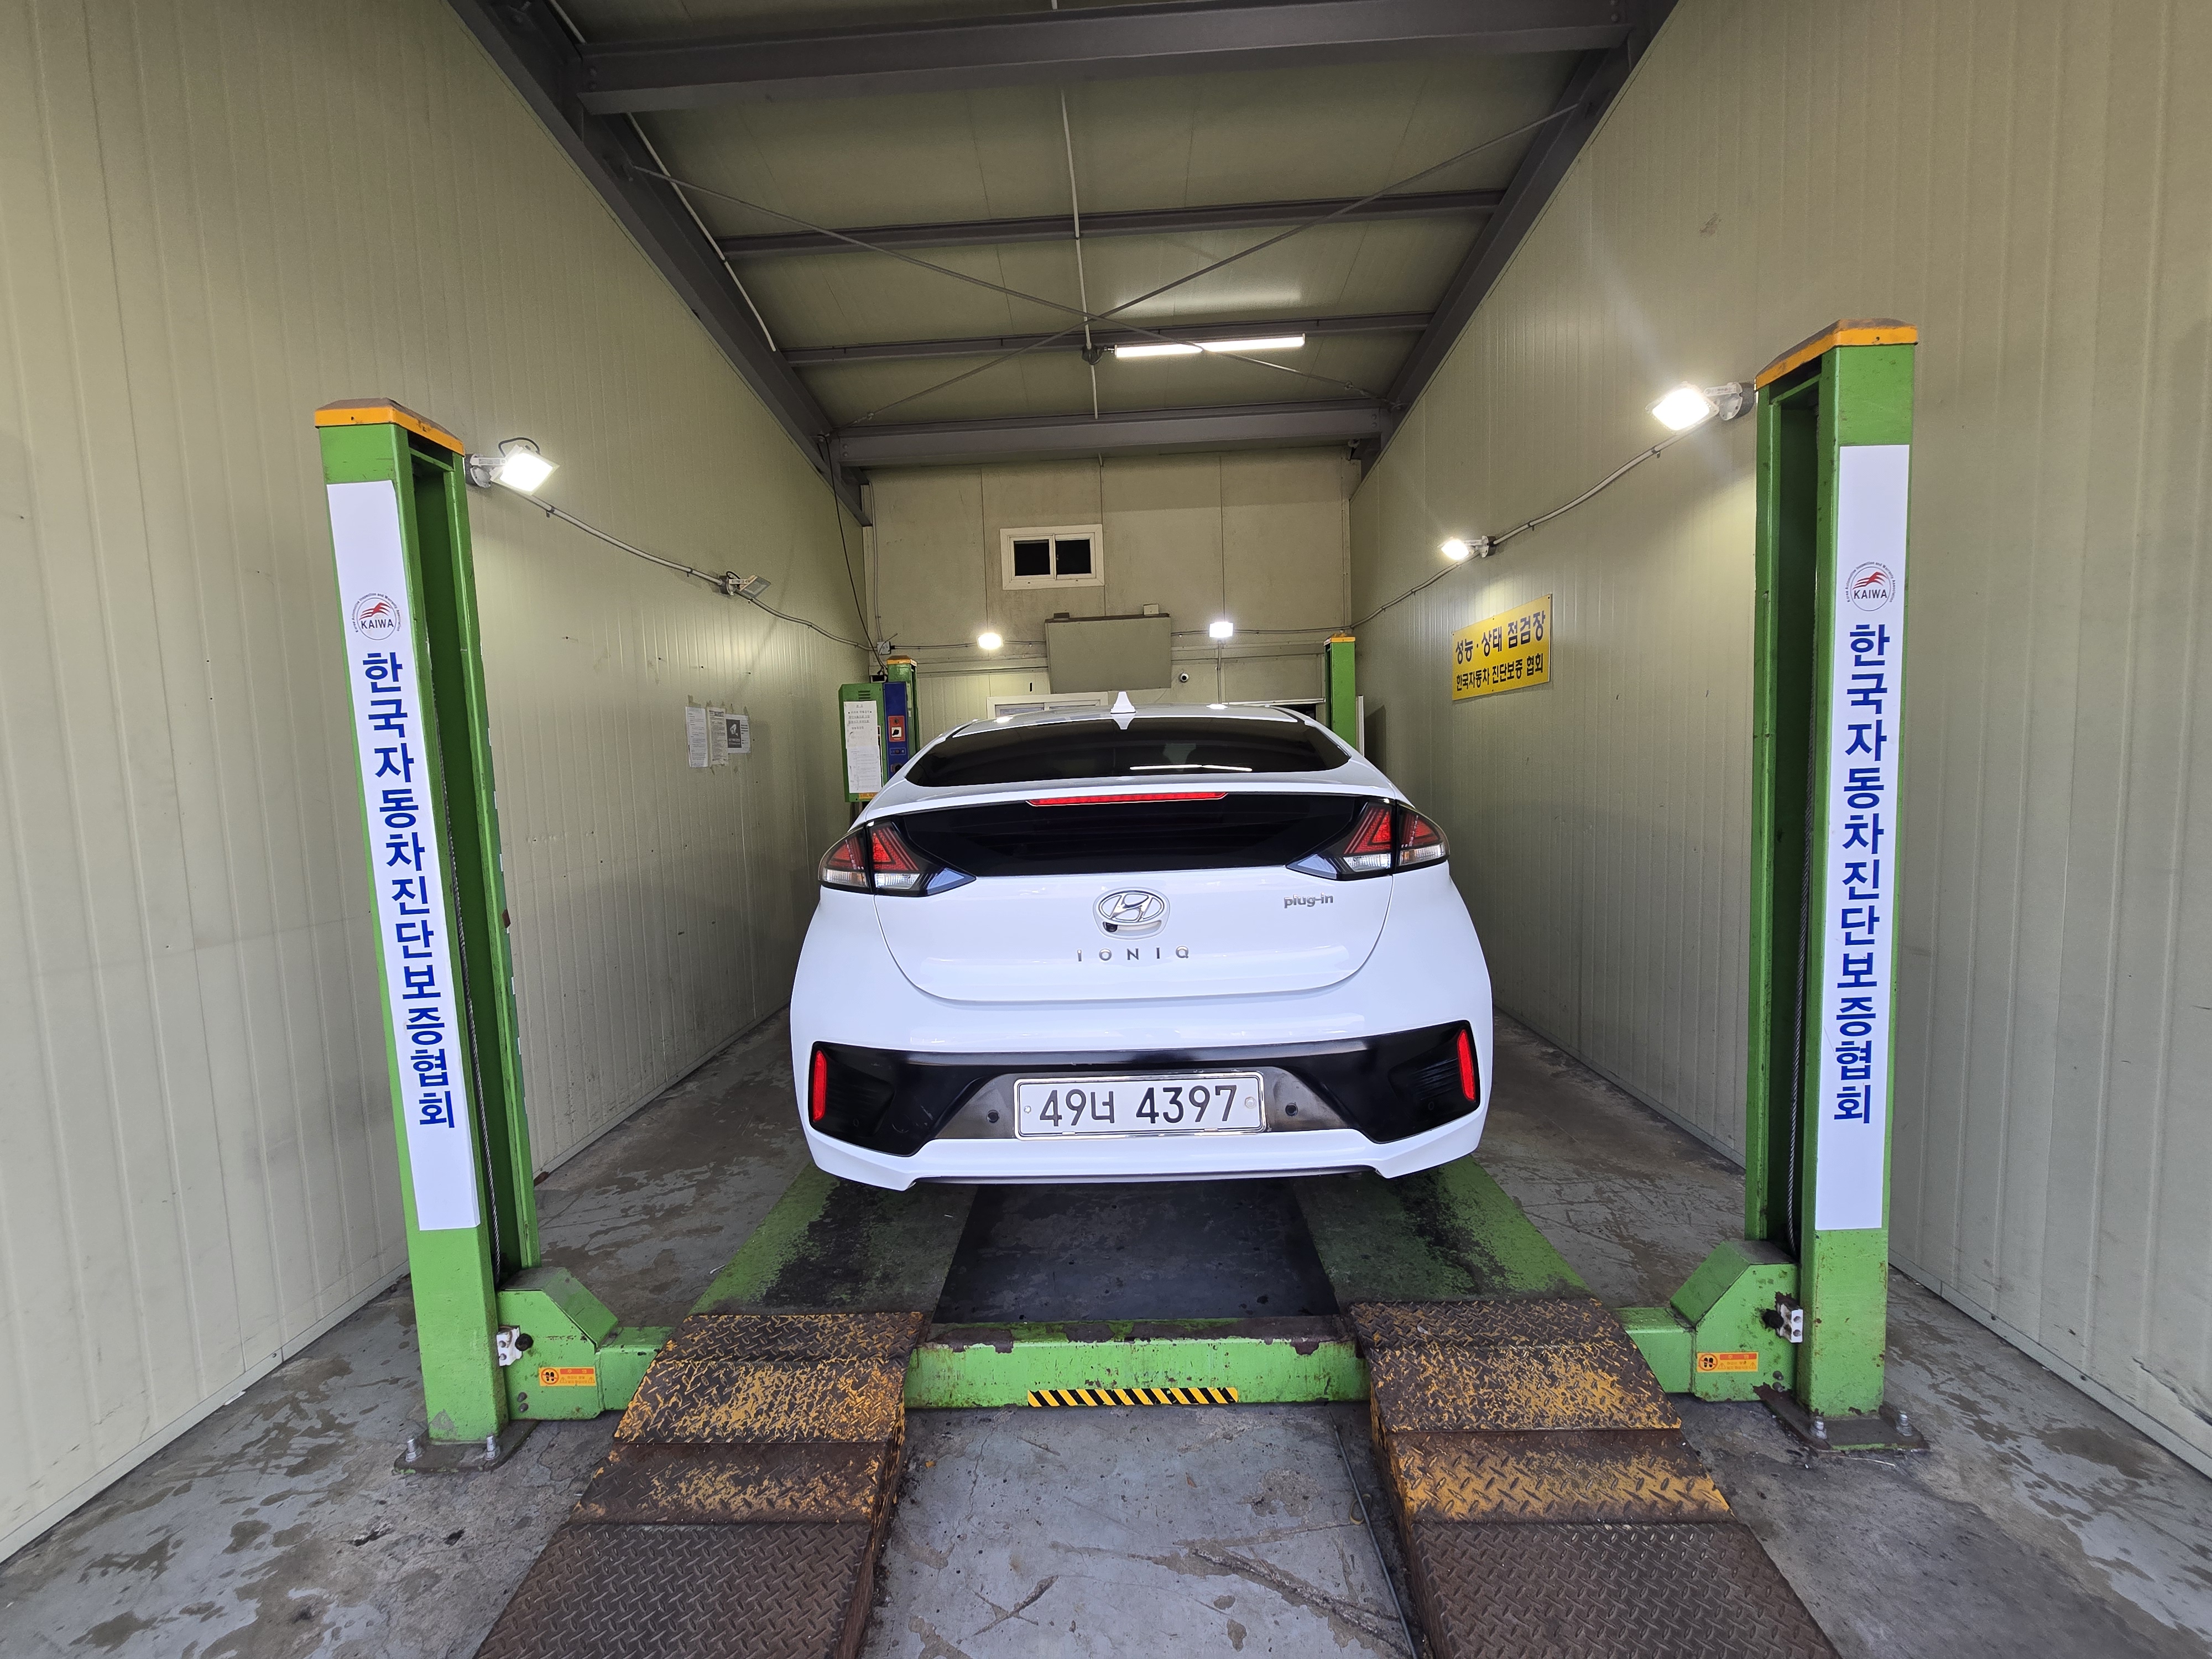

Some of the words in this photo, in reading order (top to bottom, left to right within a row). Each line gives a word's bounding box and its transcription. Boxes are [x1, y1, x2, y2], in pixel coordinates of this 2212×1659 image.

[1854, 589, 1887, 599] KAIWA
[361, 619, 394, 629] KAIWA
[1507, 610, 1546, 649] 점검장
[1456, 667, 1490, 691] 한국자동차
[1492, 659, 1523, 684] 진단보증
[1526, 653, 1543, 676] 협회
[363, 651, 455, 1128] 한국자동차진단보증협회
[1834, 624, 1890, 1124] 한국자동차진단보증협회
[1284, 892, 1334, 909] plug-in
[1076, 945, 1190, 962] IONIQ
[1039, 1089, 1114, 1126] 49너
[1135, 1084, 1238, 1124] 4397
